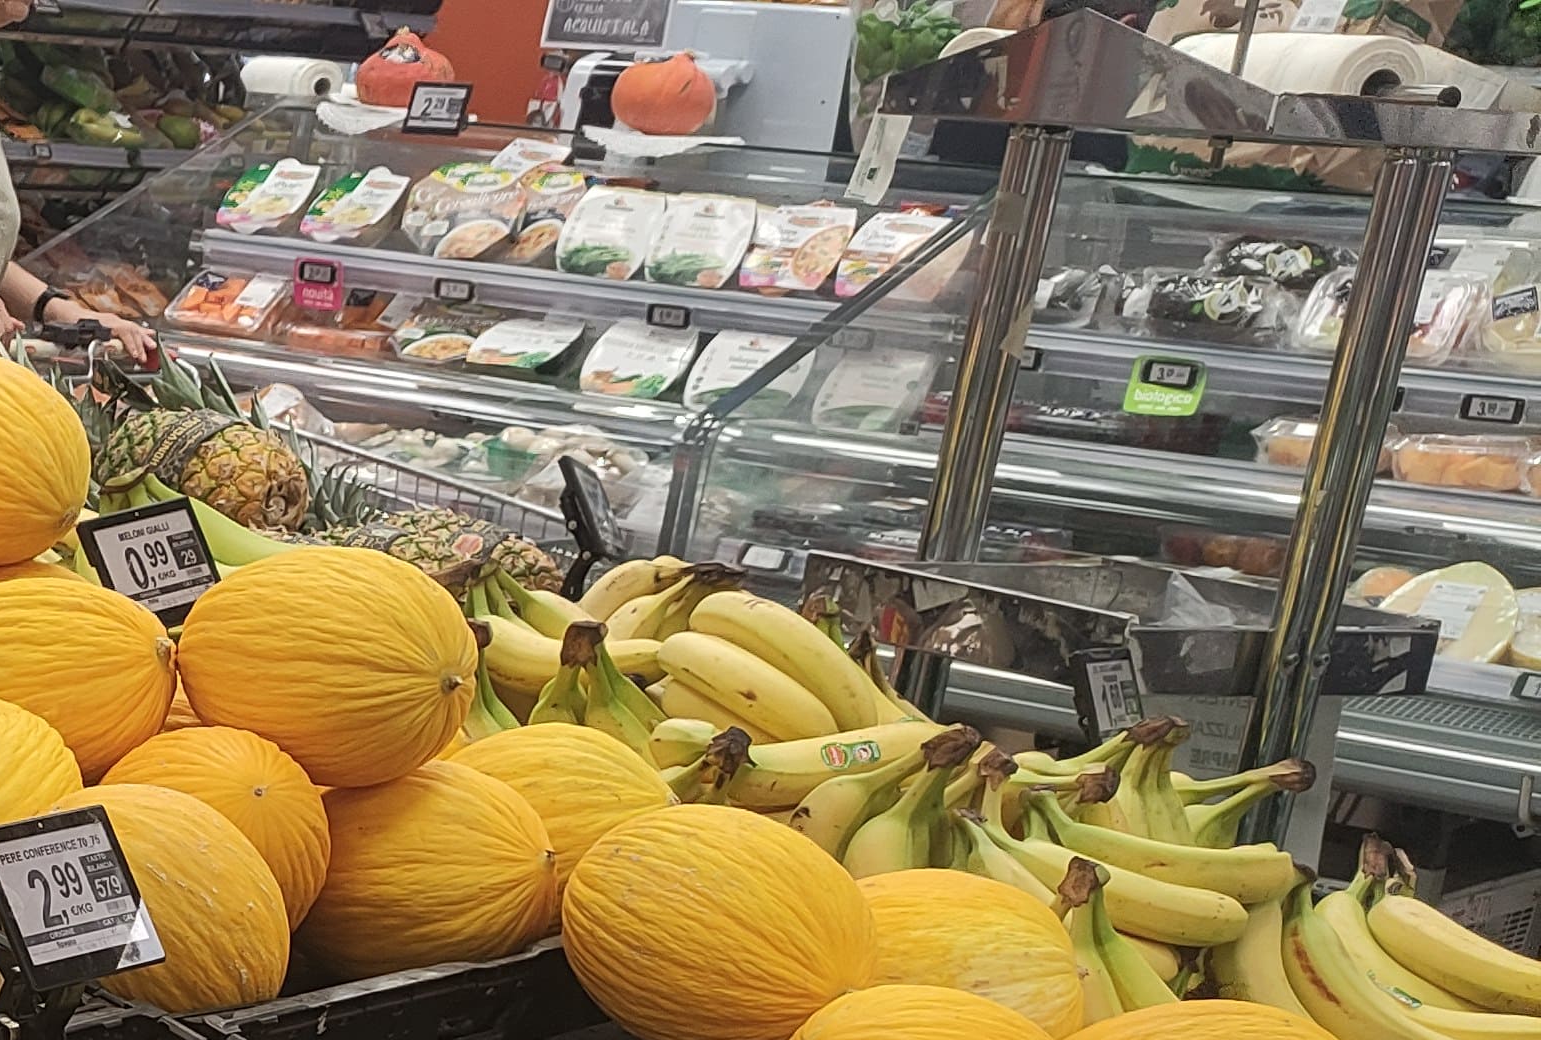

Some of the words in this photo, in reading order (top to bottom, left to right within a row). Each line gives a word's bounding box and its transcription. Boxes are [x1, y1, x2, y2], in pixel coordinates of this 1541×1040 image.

[1134, 388, 1194, 406] biologico
[180, 549, 198, 566] 29
[0, 850, 23, 866] PERE
[23, 838, 77, 860] CONFERENCE
[94, 874, 123, 898] 579
